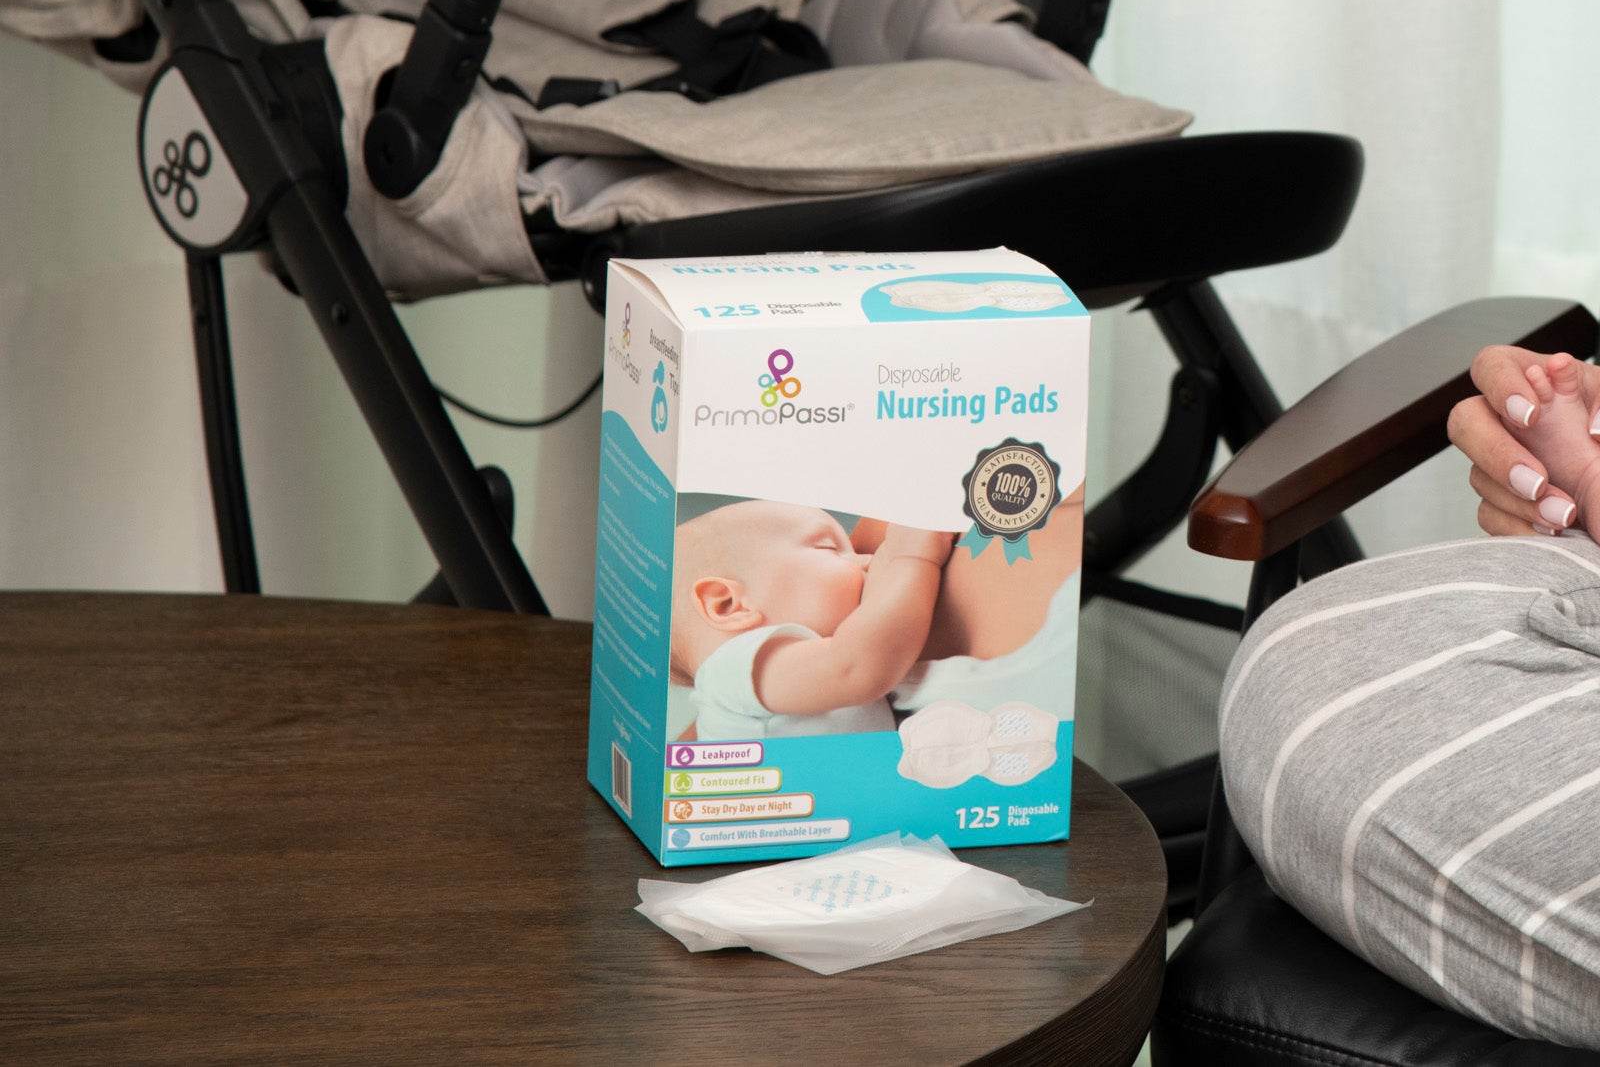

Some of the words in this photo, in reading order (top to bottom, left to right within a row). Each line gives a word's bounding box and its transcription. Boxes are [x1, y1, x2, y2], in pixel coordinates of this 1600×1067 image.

[672, 264, 820, 275] Nursing
[828, 262, 916, 272] Pads
[694, 304, 761, 318] 125
[767, 301, 843, 311] Disposable
[770, 308, 805, 316] Pads
[878, 362, 963, 388] Disposable
[876, 387, 986, 425] Nursing
[994, 383, 1059, 415] Pads
[984, 452, 1047, 484] SATISFACTION
[994, 471, 1032, 498] 100%
[991, 492, 1028, 506] QUALITY
[976, 496, 1038, 526] GUARANTEED
[702, 748, 751, 761] Leakproof
[700, 776, 751, 788] Contoured
[752, 775, 766, 785] Fit
[701, 804, 721, 815] Stay
[722, 804, 738, 814] Dry
[739, 802, 755, 813] Day
[757, 803, 767, 812] or
[768, 801, 792, 812] Night
[1007, 802, 1060, 817] Disposable
[955, 805, 1001, 830] 125
[1007, 816, 1031, 827] Pads
[700, 831, 735, 842] Comfort
[737, 829, 758, 840] With
[759, 827, 806, 839] Breathable
[808, 826, 833, 837] Layer
